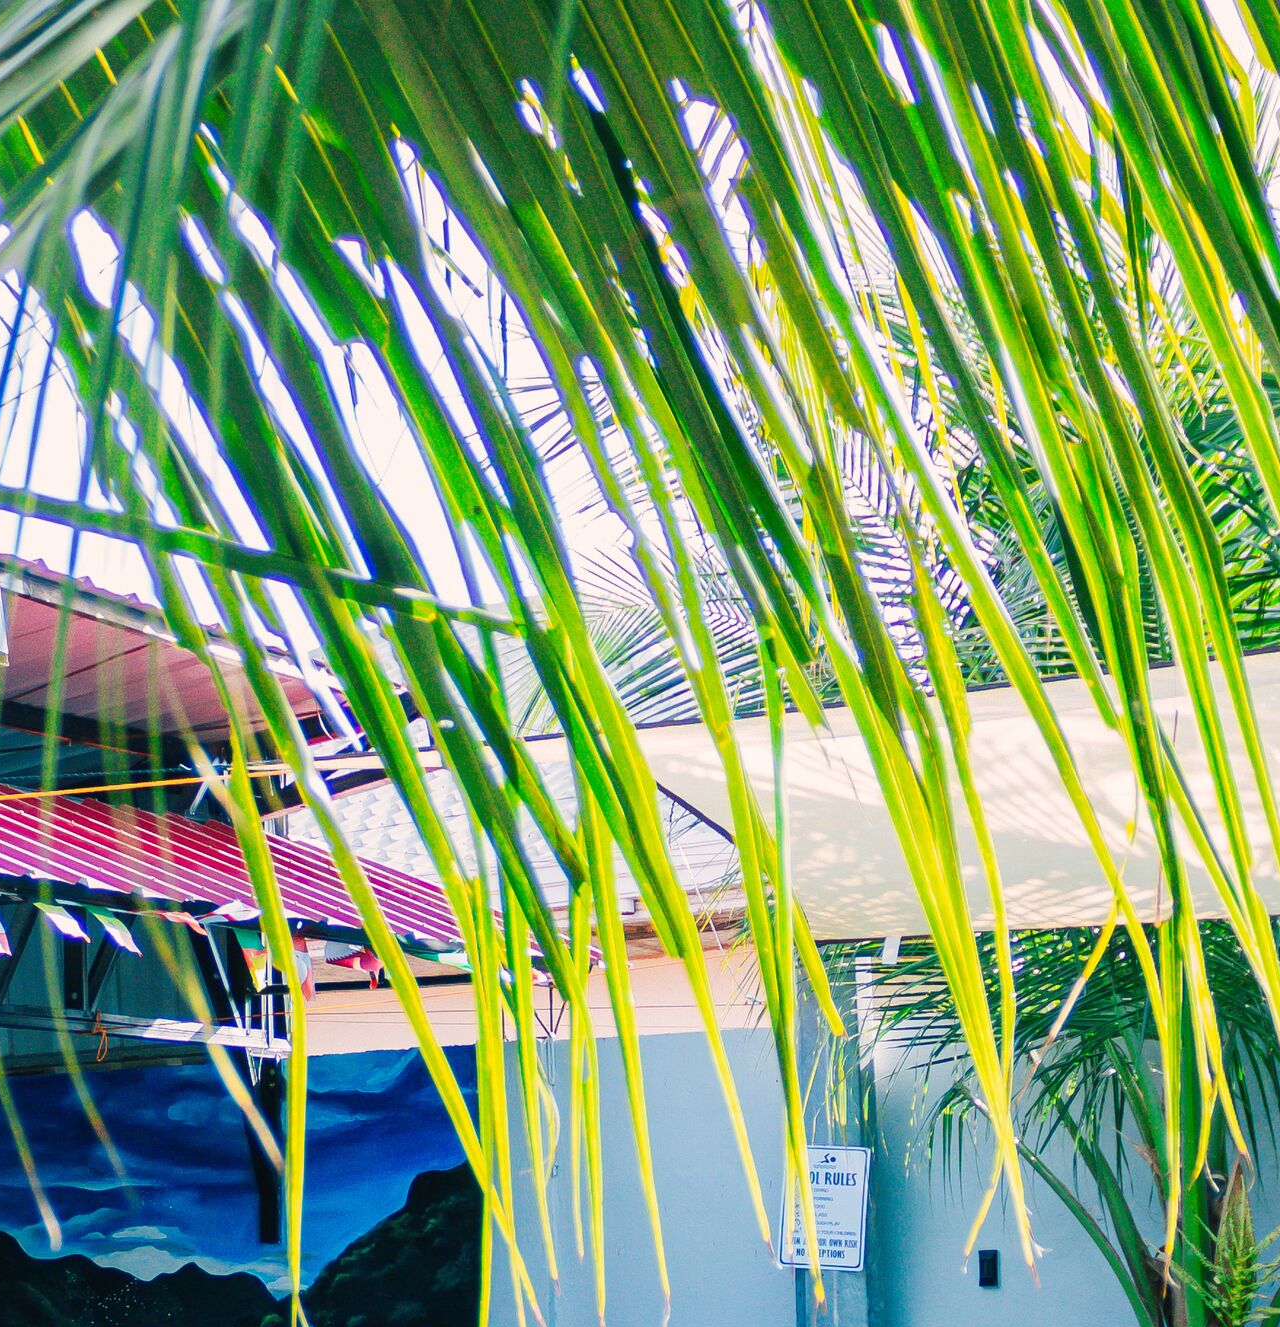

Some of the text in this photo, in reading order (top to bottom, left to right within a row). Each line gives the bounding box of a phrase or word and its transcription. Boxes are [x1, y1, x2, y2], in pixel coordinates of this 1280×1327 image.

[824, 1171, 858, 1186] RULES
[829, 1238, 842, 1247] OWN
[845, 1239, 858, 1248] RISK
[796, 1248, 845, 1259] NO EPTIONS
